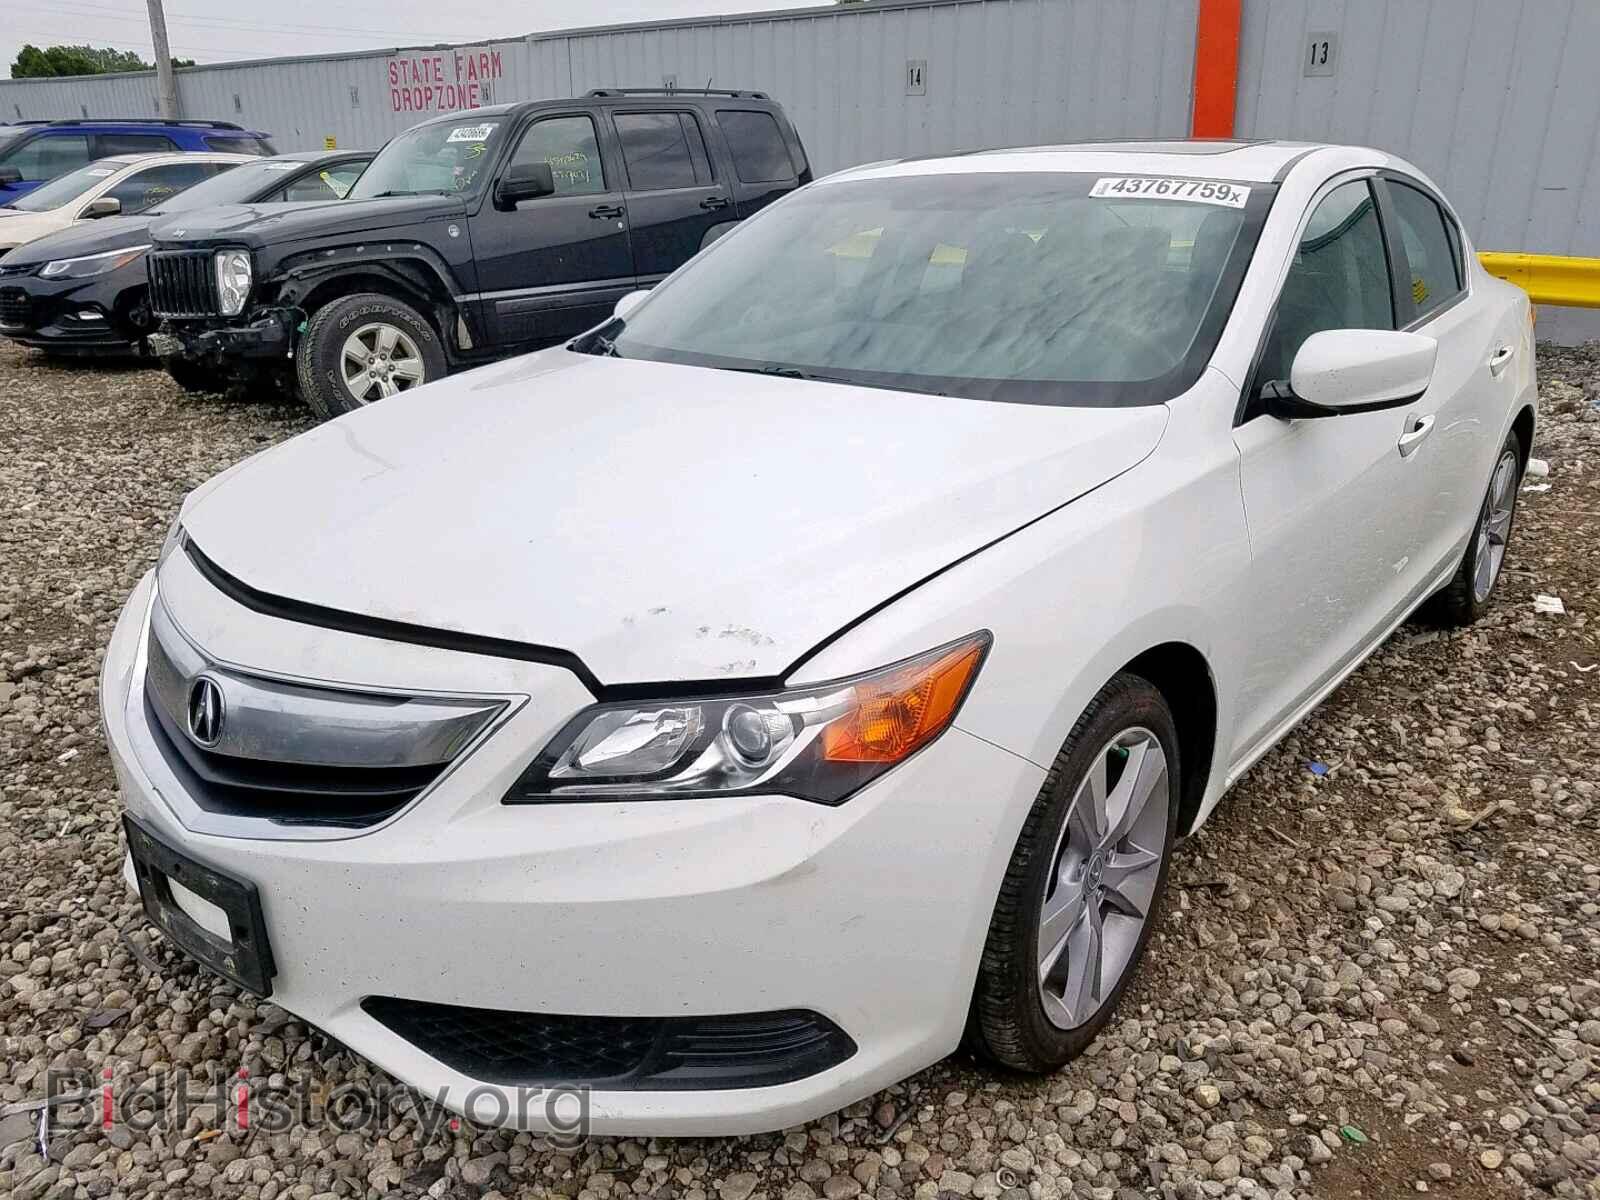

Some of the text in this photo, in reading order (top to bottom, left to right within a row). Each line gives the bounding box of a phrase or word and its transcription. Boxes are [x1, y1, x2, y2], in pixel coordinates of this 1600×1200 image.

[1311, 42, 1328, 65] 13
[388, 50, 502, 84] STATE FARM
[910, 68, 921, 86] 14
[391, 83, 480, 112] DROPZONE
